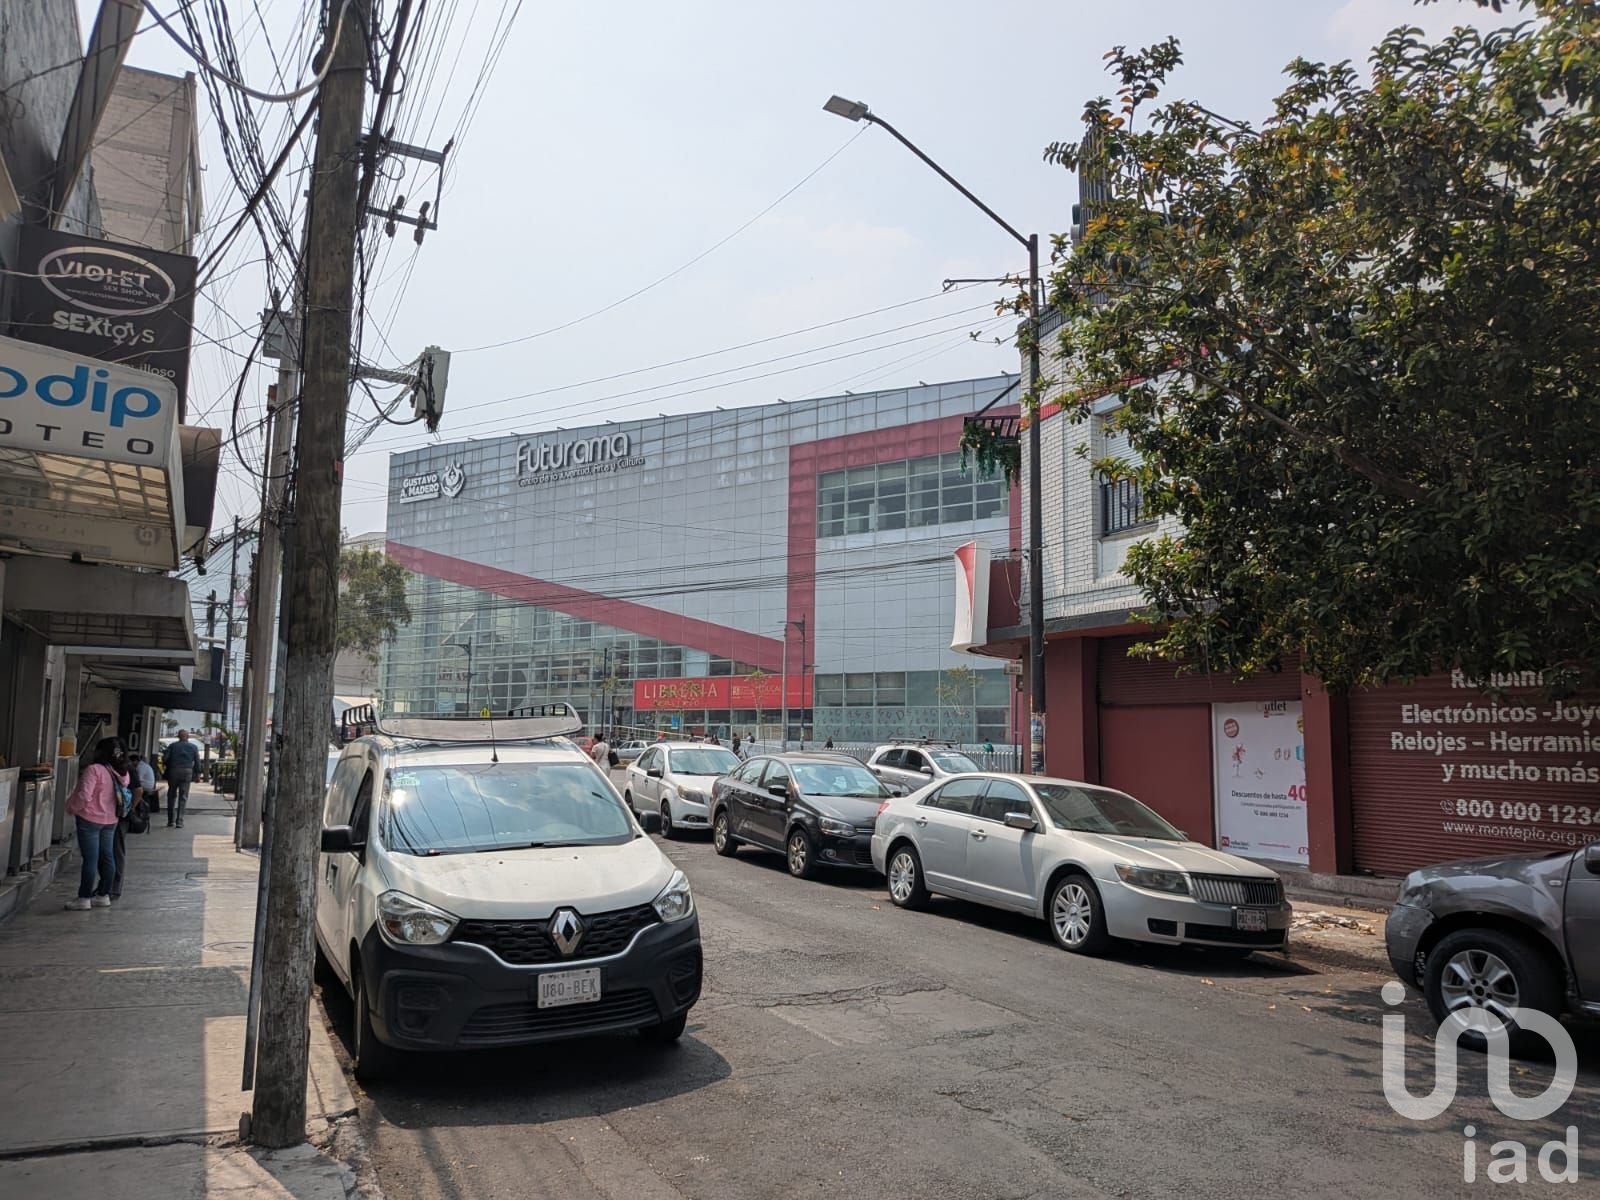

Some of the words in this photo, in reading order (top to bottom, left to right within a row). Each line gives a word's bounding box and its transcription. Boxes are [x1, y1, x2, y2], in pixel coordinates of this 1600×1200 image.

[55, 258, 151, 288] VIOLET
[120, 286, 144, 297] SHOP
[516, 431, 629, 475] Futurama
[400, 488, 408, 498] A.
[408, 483, 440, 497] MADERO
[403, 474, 438, 488] GUSTAVO
[1401, 702, 1537, 724] Electrónicos
[1391, 732, 1467, 755] Relojes
[1441, 763, 1455, 782] y
[1461, 759, 1541, 782] mucho
[1547, 760, 1600, 783] más
[1231, 790, 1263, 800] Descuentos
[1263, 791, 1271, 800] de
[1271, 792, 1287, 801] hasta
[1456, 798, 1494, 818] 800
[1500, 801, 1541, 822] 000
